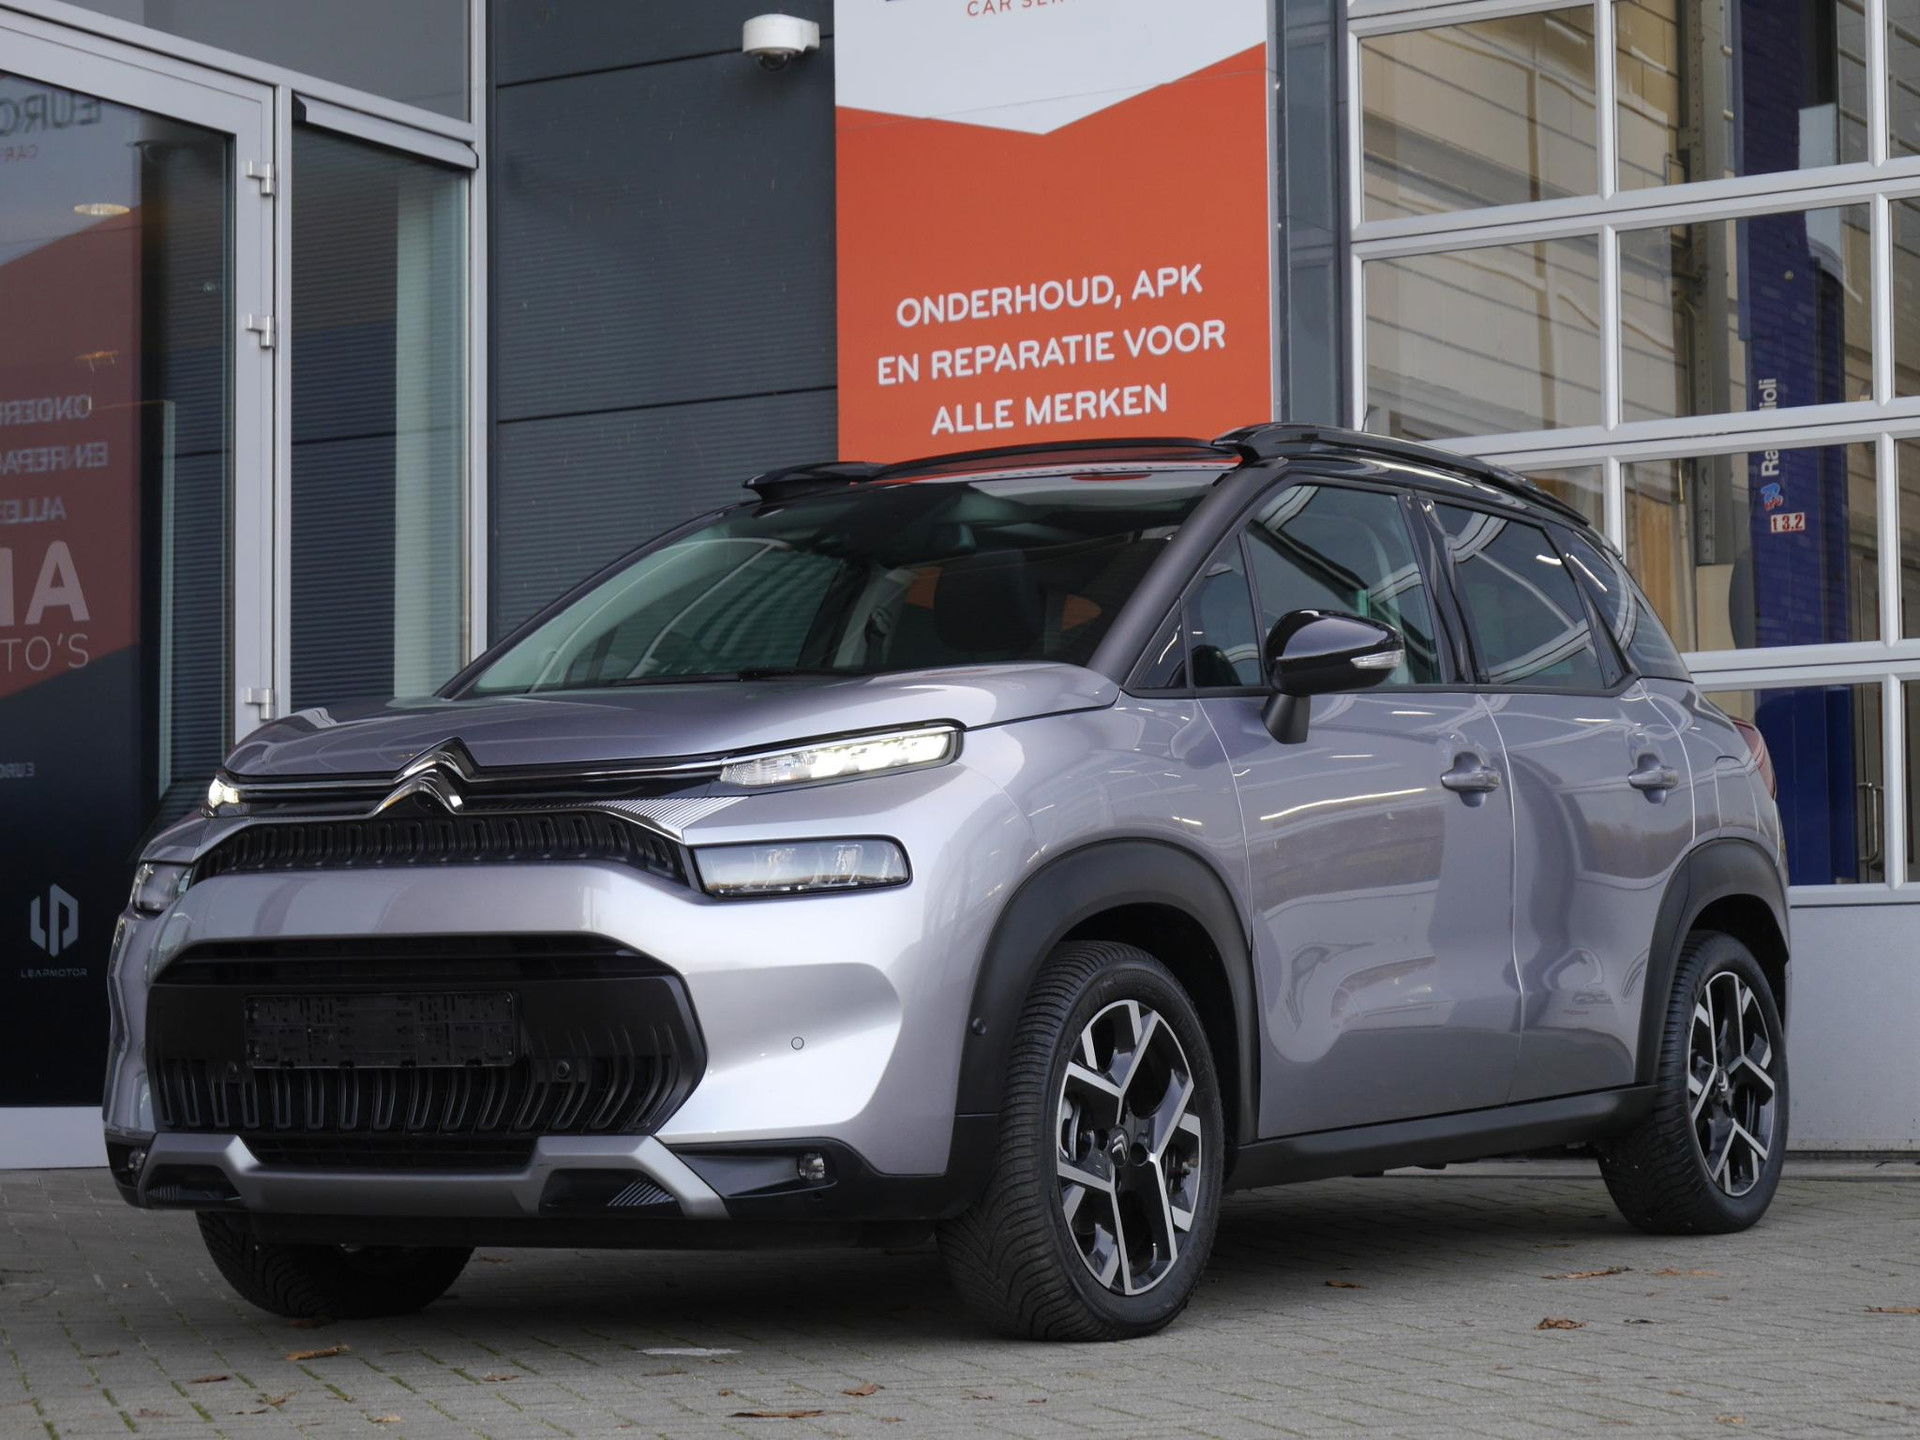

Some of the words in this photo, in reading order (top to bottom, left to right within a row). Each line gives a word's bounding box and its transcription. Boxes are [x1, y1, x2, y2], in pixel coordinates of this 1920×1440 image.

[966, 0, 1012, 17] CAR
[896, 275, 1122, 328] ONDERHOUD,
[1131, 263, 1203, 300] APK
[877, 354, 919, 385] EN
[931, 331, 1115, 380] REPARATIE
[1123, 319, 1226, 358] VOOR
[931, 399, 1013, 435] ALLE
[1025, 383, 1168, 427] MERKEN
